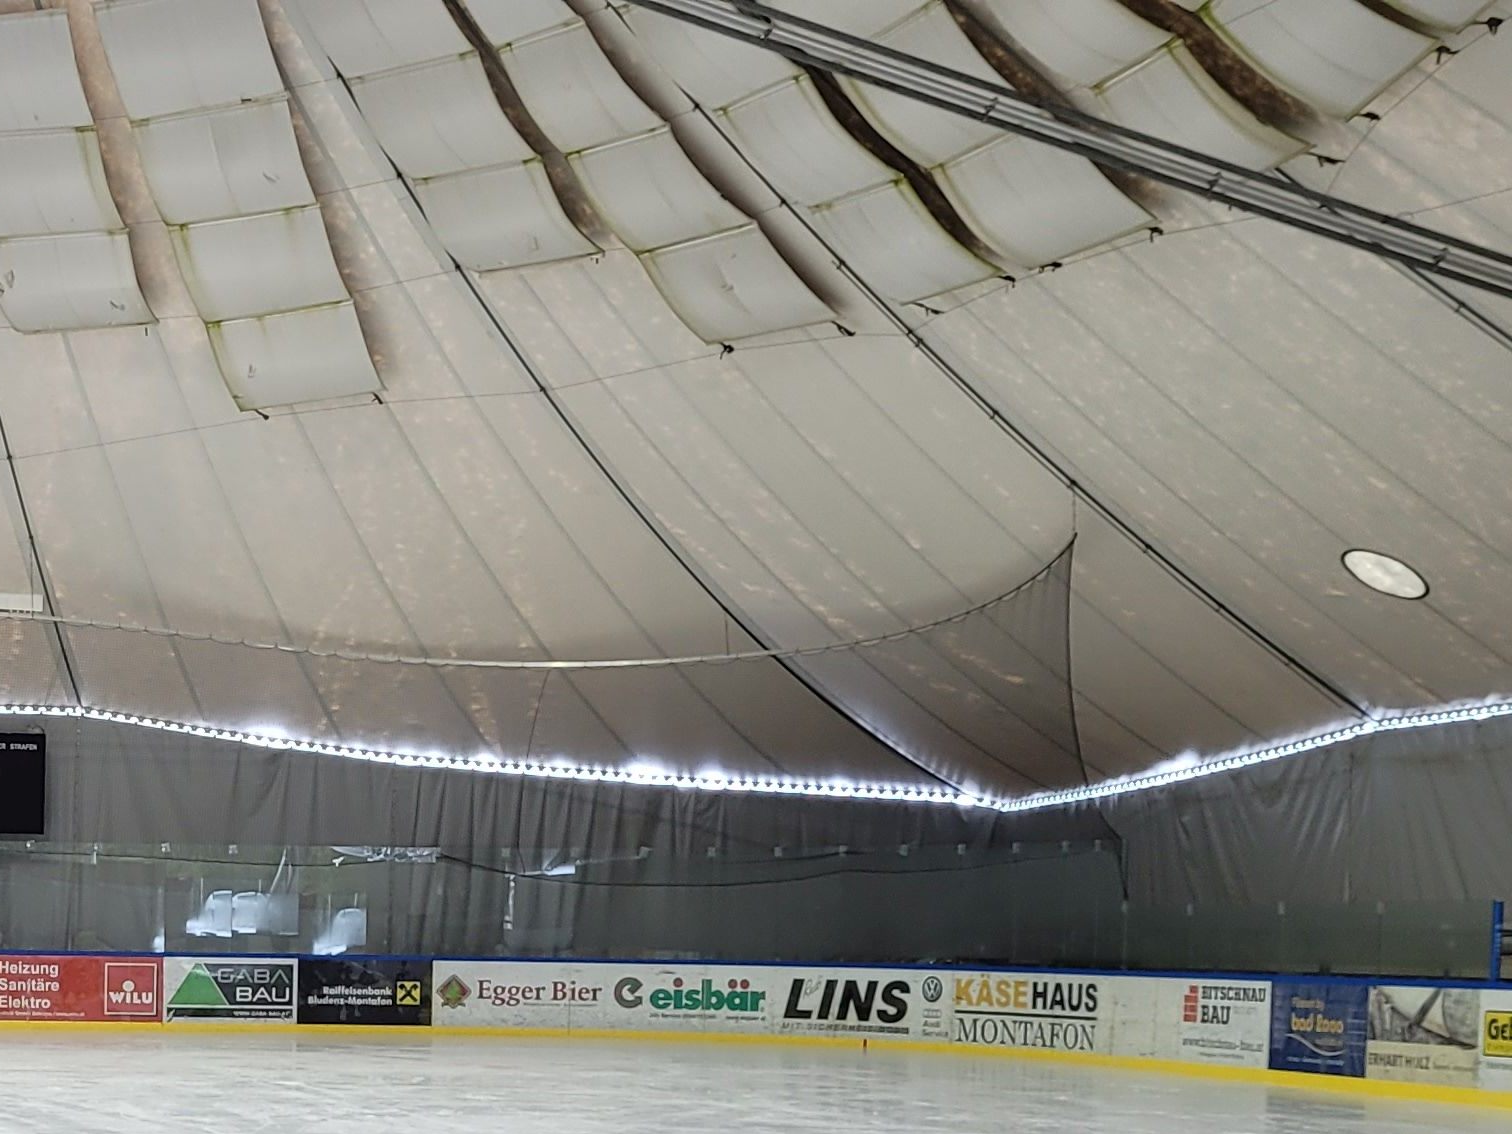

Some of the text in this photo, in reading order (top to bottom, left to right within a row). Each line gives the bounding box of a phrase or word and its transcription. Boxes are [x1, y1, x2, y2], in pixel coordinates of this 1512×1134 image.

[217, 968, 290, 984] GABA
[236, 987, 290, 1002] BAU
[323, 986, 392, 996] Raiffeisenbank
[477, 979, 602, 1007] Egger Bier
[649, 977, 766, 1012] eisbär
[1201, 986, 1266, 1002] BITSCHNAU
[308, 995, 392, 1006] Bludenz-Montafon
[783, 978, 911, 1023] LINS
[1200, 1005, 1231, 1025] BAU
[955, 1018, 1095, 1050] MONTAFON
